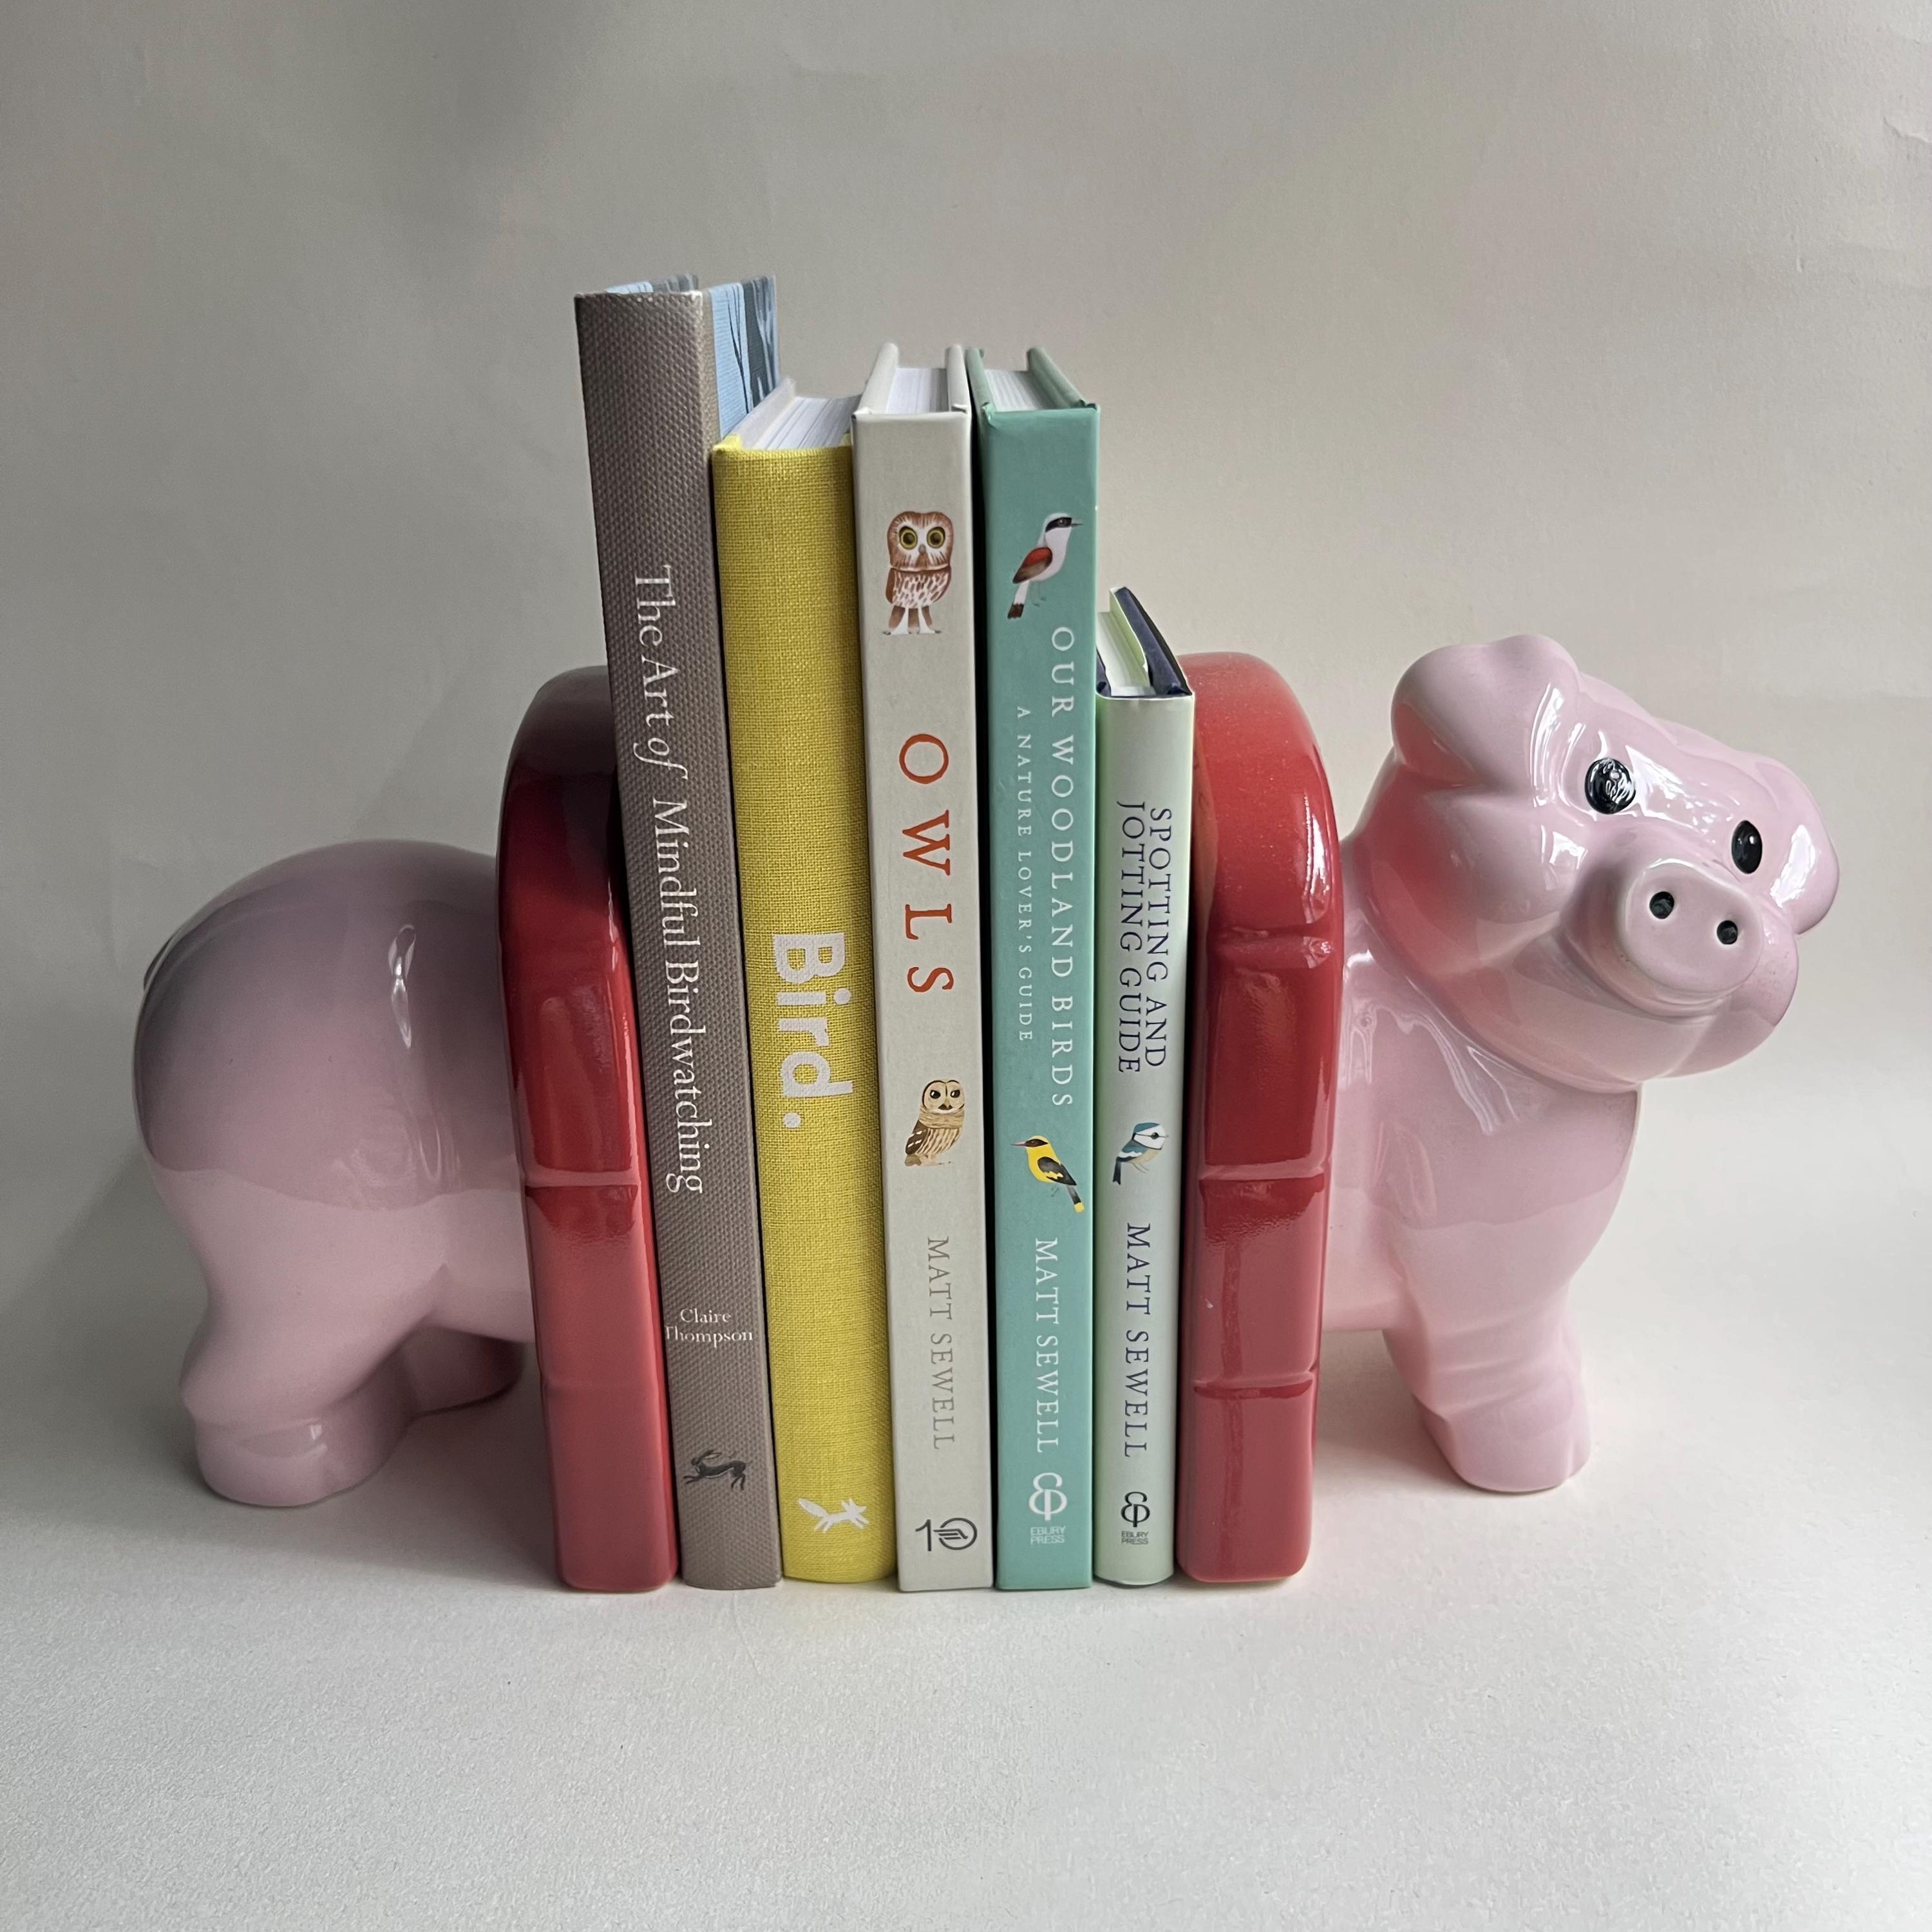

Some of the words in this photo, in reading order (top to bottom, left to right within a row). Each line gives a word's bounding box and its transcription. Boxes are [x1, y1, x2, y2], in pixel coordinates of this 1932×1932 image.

[634, 564, 677, 648] The
[641, 655, 678, 728] Art
[1018, 706, 1031, 719] A
[1051, 626, 1075, 718] OUR
[634, 737, 688, 781] of
[1017, 734, 1032, 835] NATURE
[652, 797, 701, 947] Mindful
[898, 732, 954, 995] OWLS
[1018, 850, 1032, 954] LOVER'S
[1050, 734, 1074, 978] WOODLAND
[1117, 800, 1145, 953] JOTTING
[1146, 808, 1172, 983] SPOTTING
[773, 932, 854, 1129] Bird.
[1018, 967, 1033, 1042] GUIDE
[1051, 995, 1074, 1107] BIRDS
[1118, 969, 1142, 1074] GUIDE
[1145, 998, 1168, 1069] AND
[665, 958, 711, 1195] Birdwatching
[680, 1308, 732, 1323] Claire
[927, 1236, 953, 1321] MATT
[1034, 1236, 1060, 1325] MATT
[1126, 1222, 1151, 1316] MATT
[664, 1325, 753, 1348] Thompson
[930, 1332, 956, 1451] SEWELL
[1036, 1334, 1060, 1454] SEWELL
[1124, 1329, 1150, 1457] SEWELL
[1030, 1526, 1066, 1535] EBURY
[1030, 1535, 1065, 1544] PRESS
